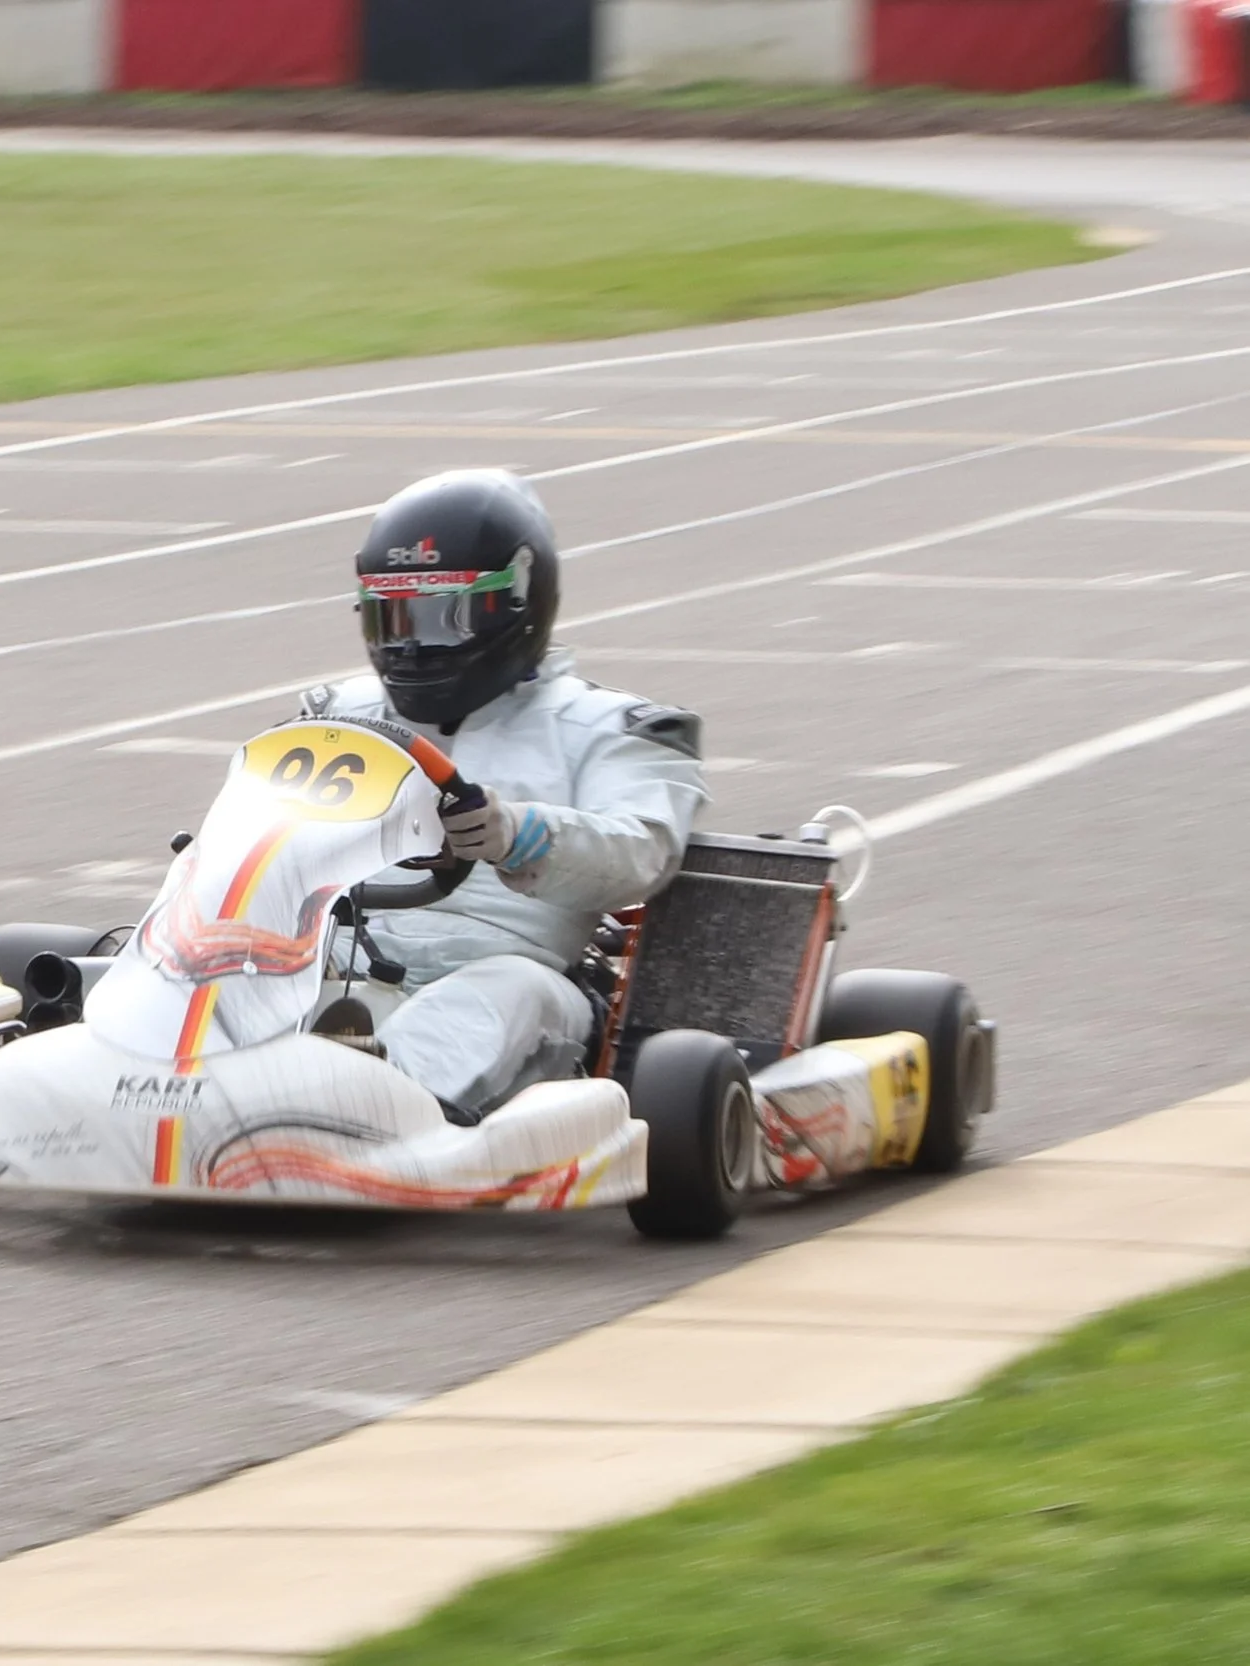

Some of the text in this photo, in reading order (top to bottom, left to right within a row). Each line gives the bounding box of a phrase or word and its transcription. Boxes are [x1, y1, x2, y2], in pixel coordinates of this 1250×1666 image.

[387, 540, 441, 566] Stilo
[269, 747, 366, 807] 96
[115, 1073, 210, 1097] KART
